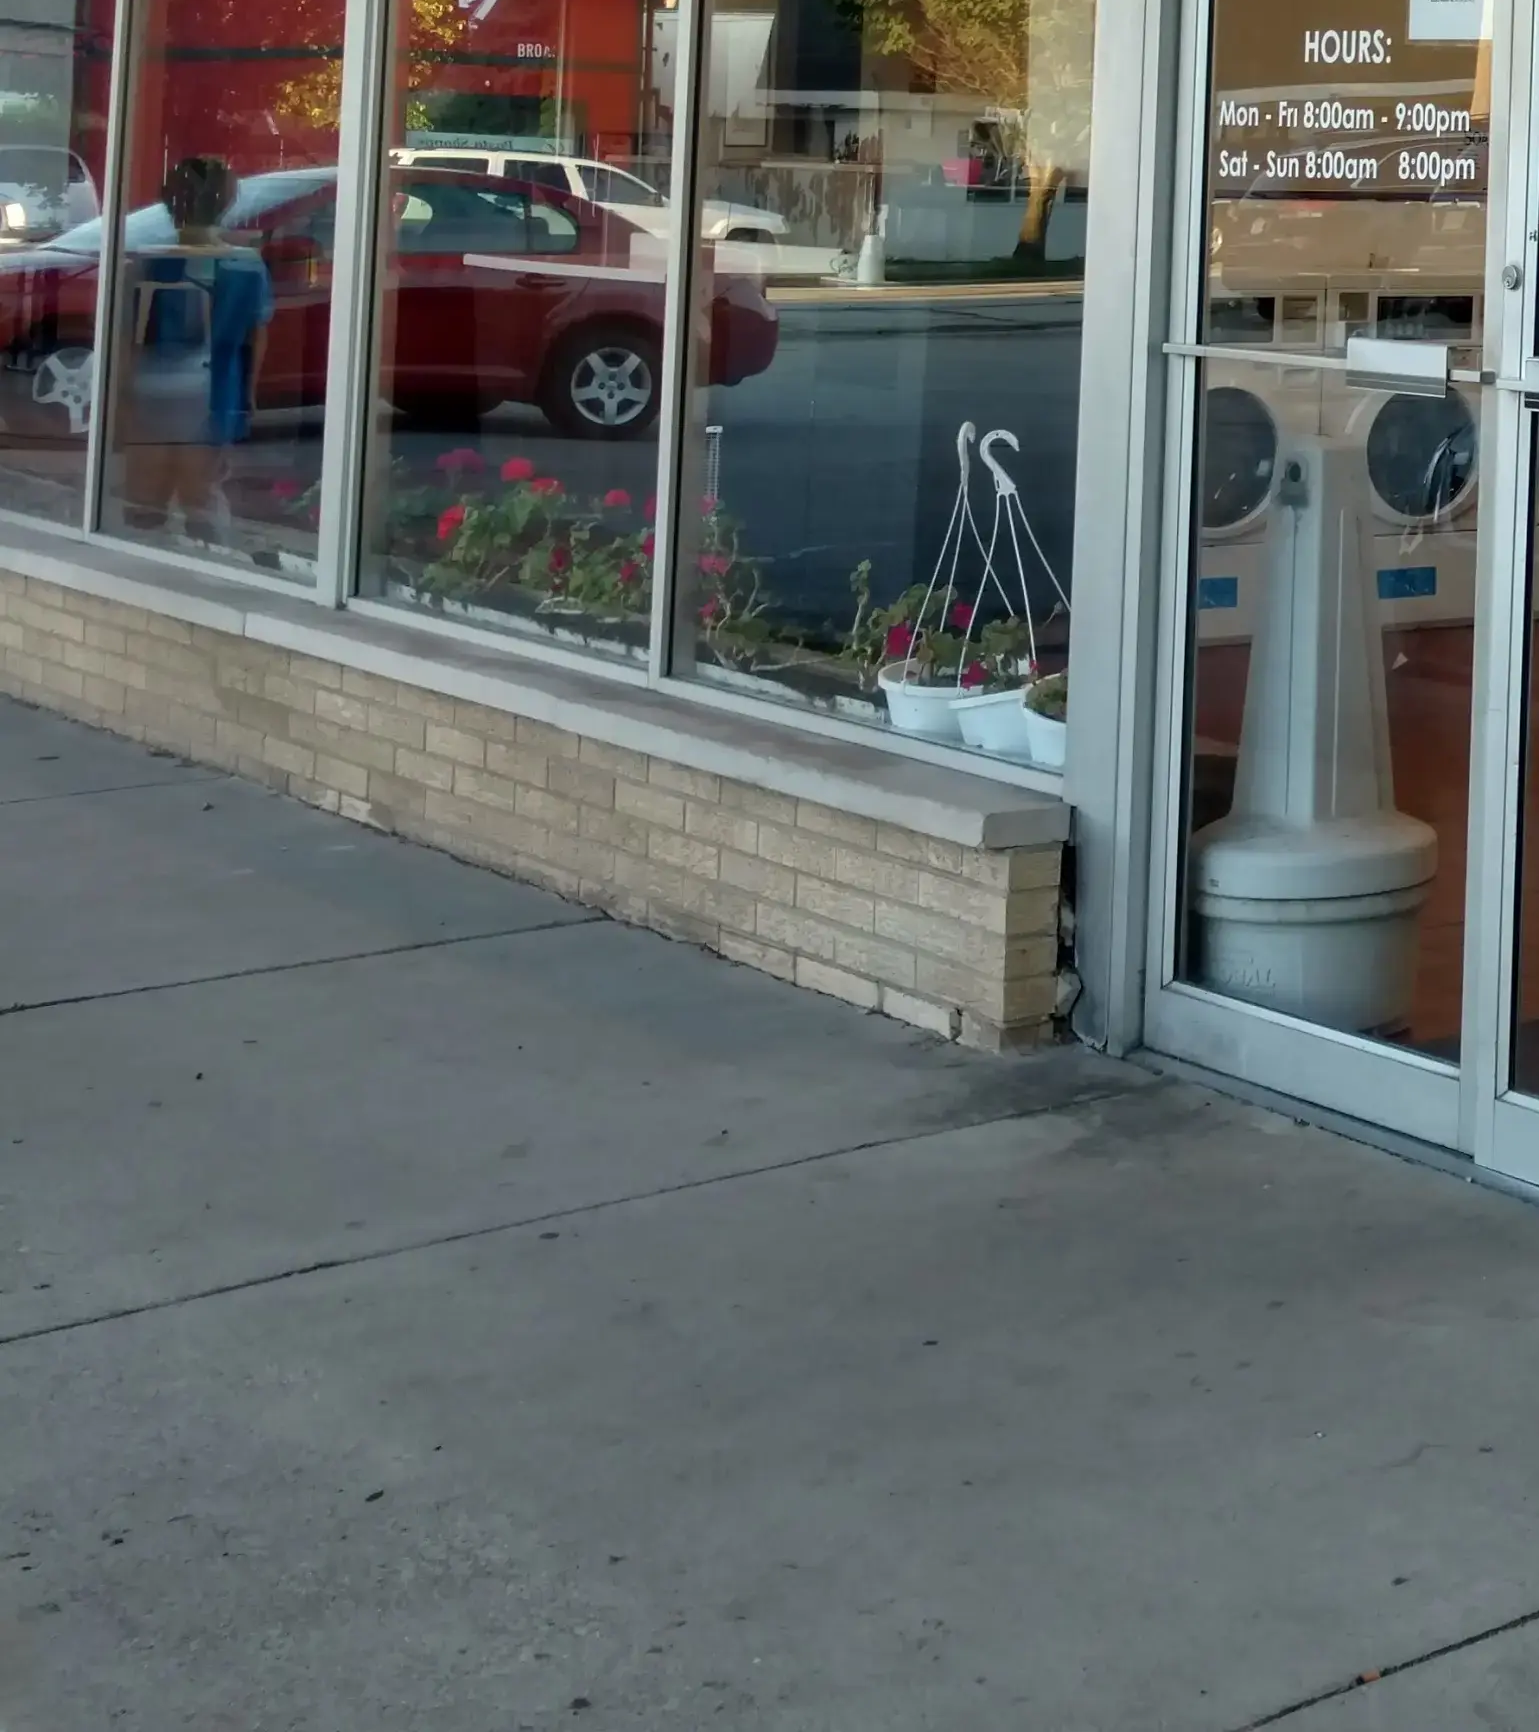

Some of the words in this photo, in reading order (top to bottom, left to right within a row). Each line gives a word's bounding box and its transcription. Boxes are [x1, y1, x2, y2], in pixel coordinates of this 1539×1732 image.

[1304, 29, 1392, 64] HOURS:
[1219, 101, 1259, 127] Mon
[1278, 101, 1298, 128] Fri
[1303, 101, 1374, 129] 8:00am
[1395, 103, 1470, 137] 9:00pm
[1219, 150, 1248, 178] Sat
[1266, 151, 1300, 179] Sun
[1305, 151, 1377, 180] 8:00am
[1398, 151, 1476, 187] 8:00pm
